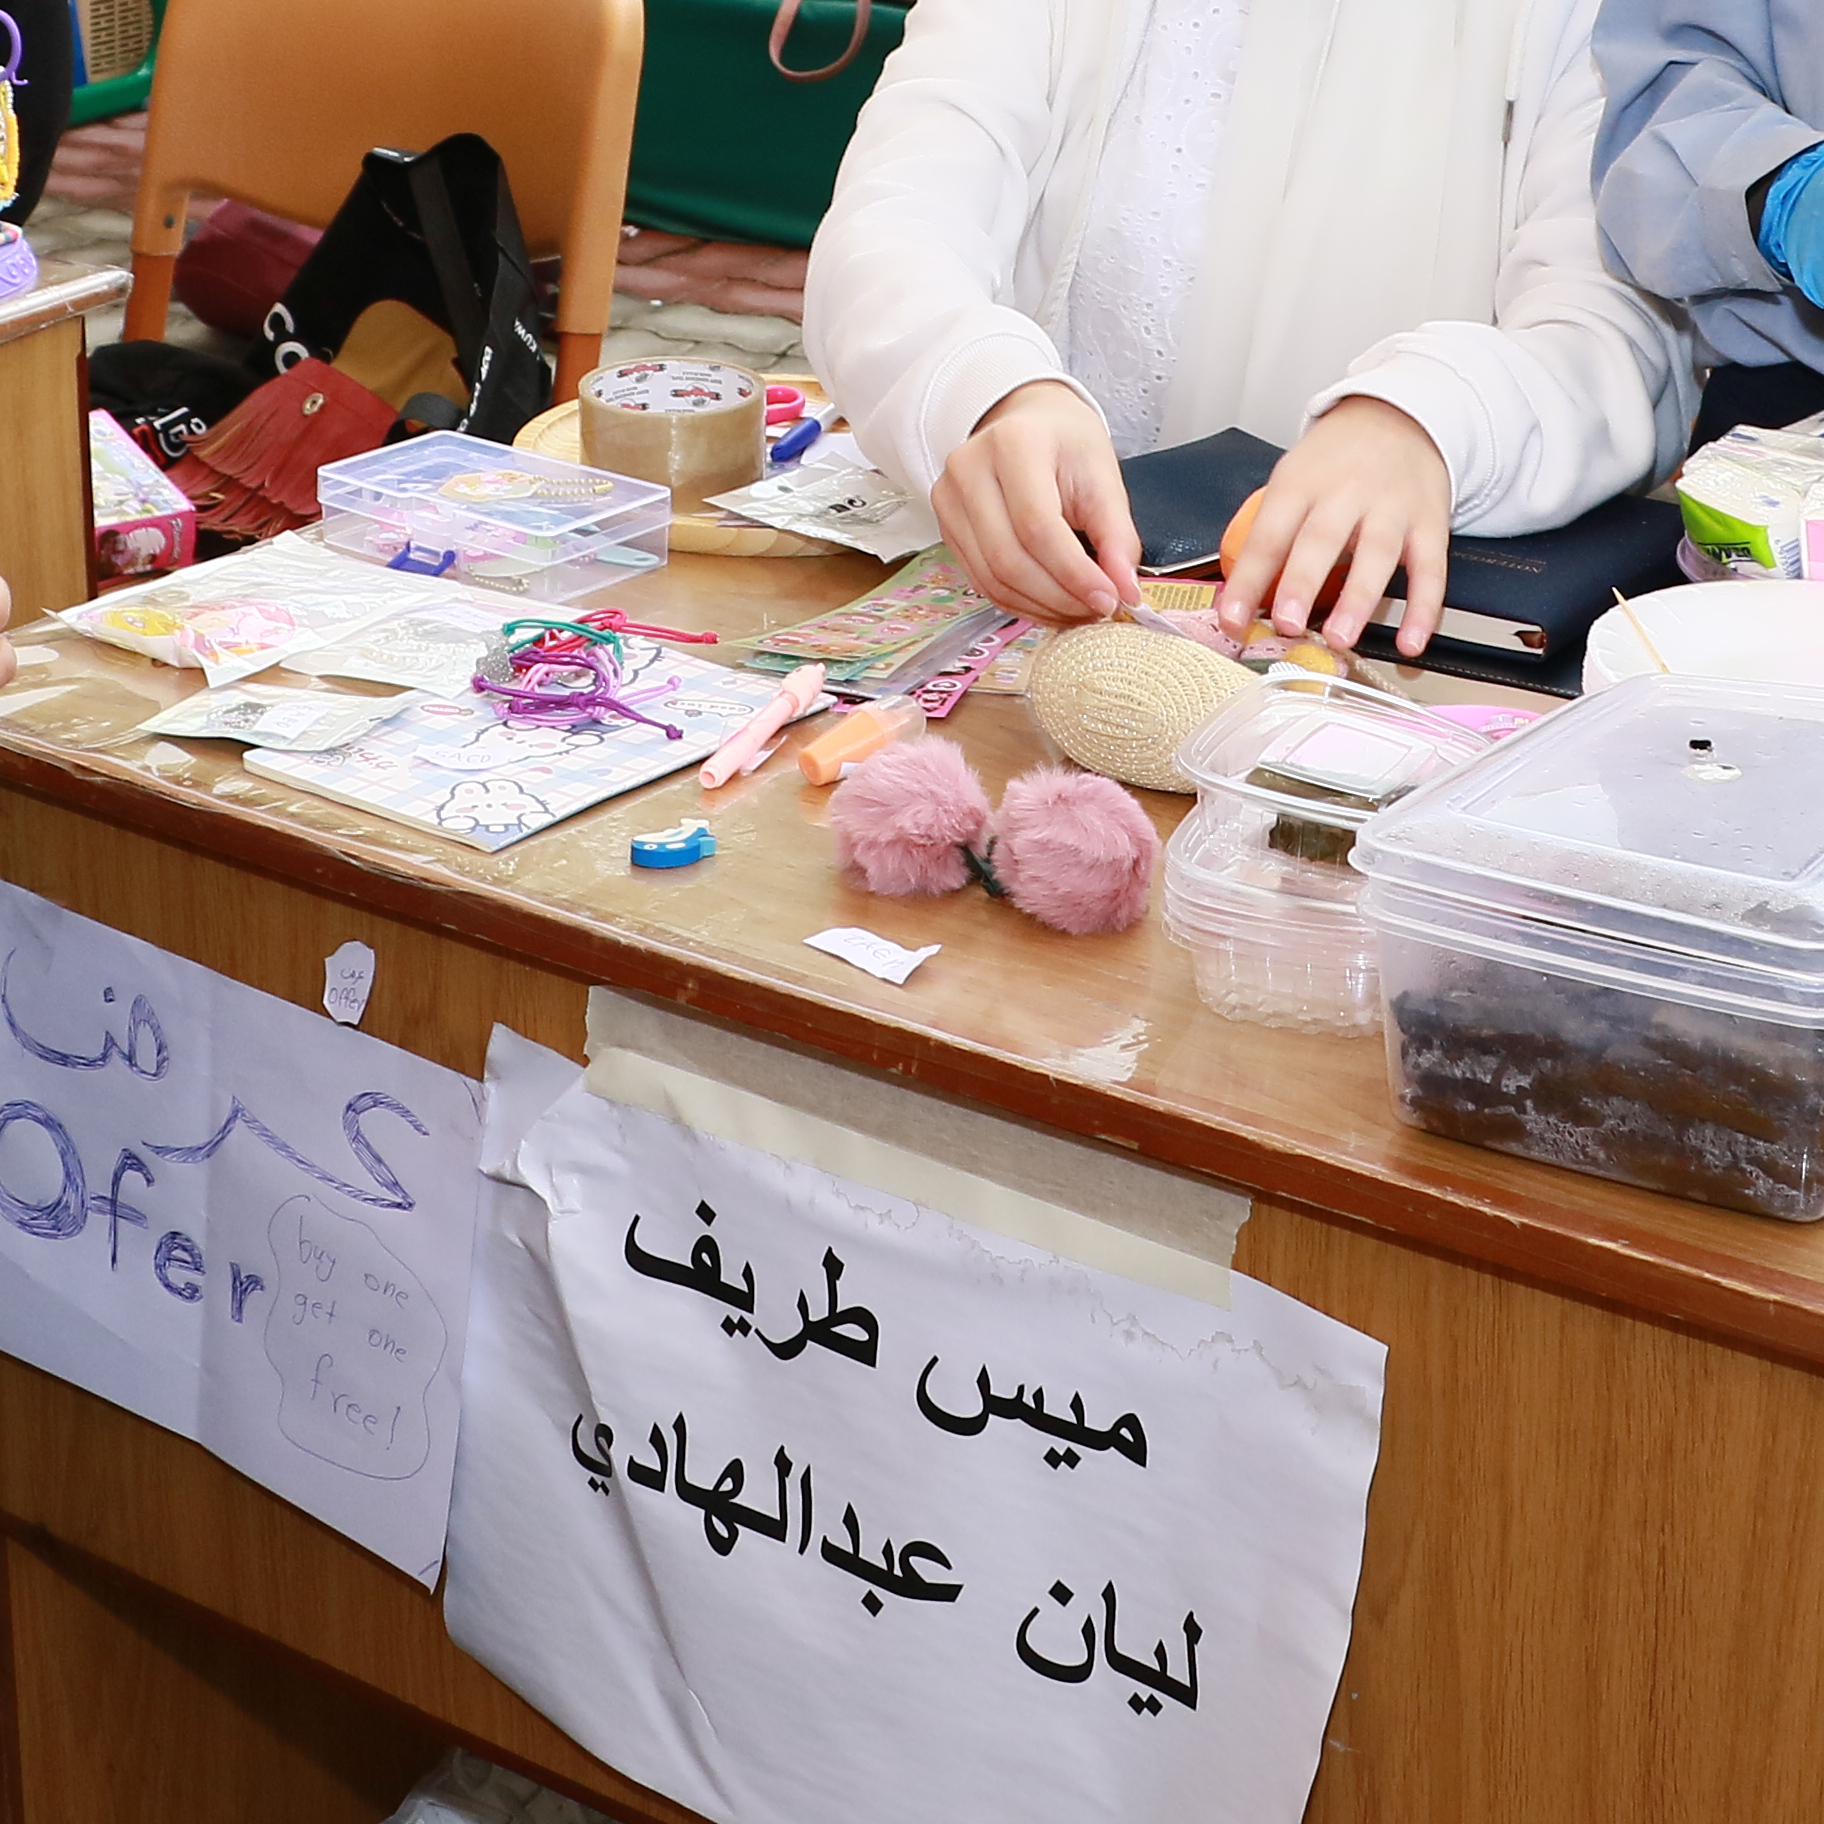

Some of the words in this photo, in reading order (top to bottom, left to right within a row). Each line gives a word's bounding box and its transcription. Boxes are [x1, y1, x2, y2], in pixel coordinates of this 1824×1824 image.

[327, 986, 366, 1013] Offer
[298, 1215, 337, 1283] buy
[363, 1272, 409, 1309] one
[622, 1200, 881, 1372] طريف
[292, 1292, 337, 1326] get
[367, 1328, 408, 1363] one
[915, 1351, 1151, 1470] ميس
[1013, 1579, 1205, 1718] ليان
